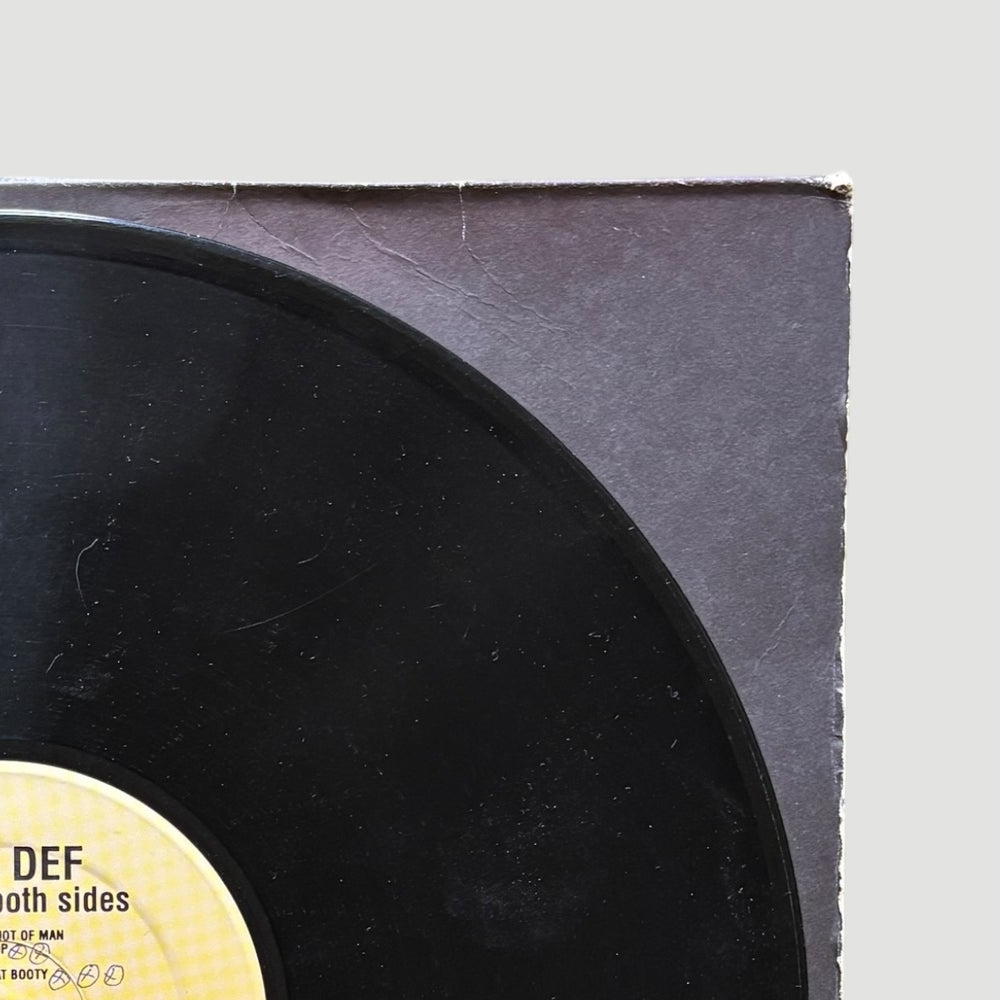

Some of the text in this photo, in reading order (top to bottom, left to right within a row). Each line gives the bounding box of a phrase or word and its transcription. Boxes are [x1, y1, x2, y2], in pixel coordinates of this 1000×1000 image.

[13, 845, 84, 882] DEF
[58, 886, 130, 912] sides
[21, 930, 34, 941] OF
[39, 930, 64, 940] MAN
[11, 969, 48, 980] BOOTY
